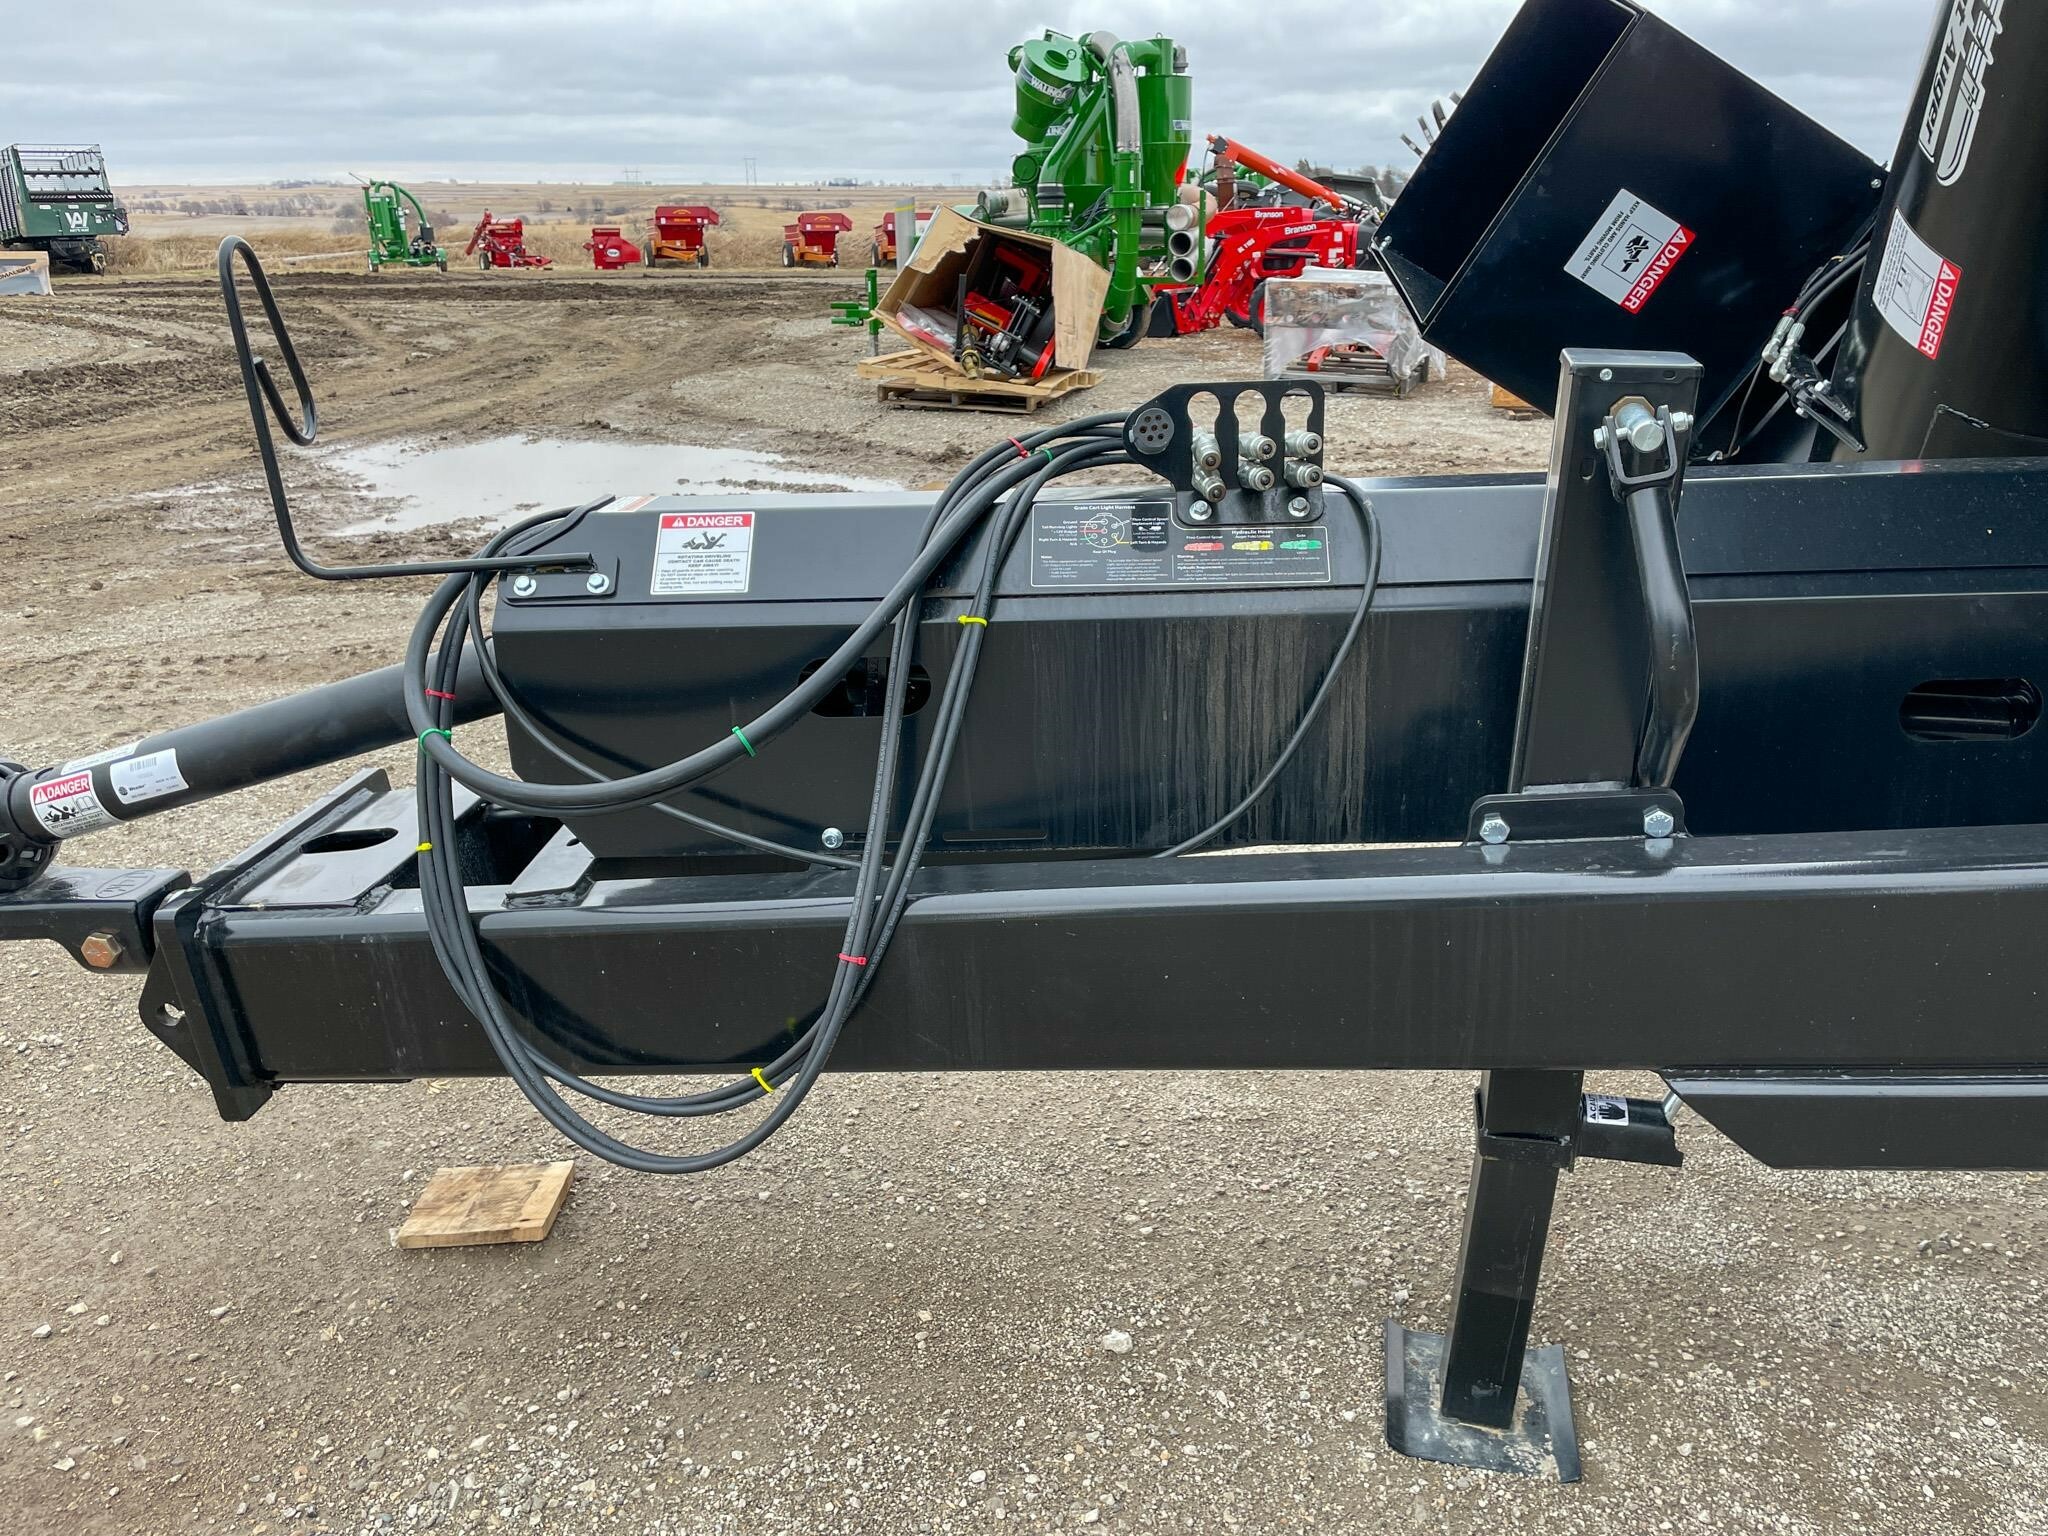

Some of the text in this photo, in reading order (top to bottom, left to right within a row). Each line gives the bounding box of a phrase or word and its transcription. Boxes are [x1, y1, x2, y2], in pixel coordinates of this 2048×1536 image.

[1927, 27, 1956, 145] Auger
[1254, 210, 1284, 219] Branson
[1284, 223, 1317, 236] Branson
[1580, 200, 1641, 279] KEEP HANDS AND CLOTHING AWAY
[1584, 211, 1624, 262] FROM MOVING PARTS.
[1624, 245, 1679, 309] DANGER
[1921, 281, 1954, 356] DANGER
[687, 516, 743, 527] DANGER
[47, 778, 90, 799] DANGER
